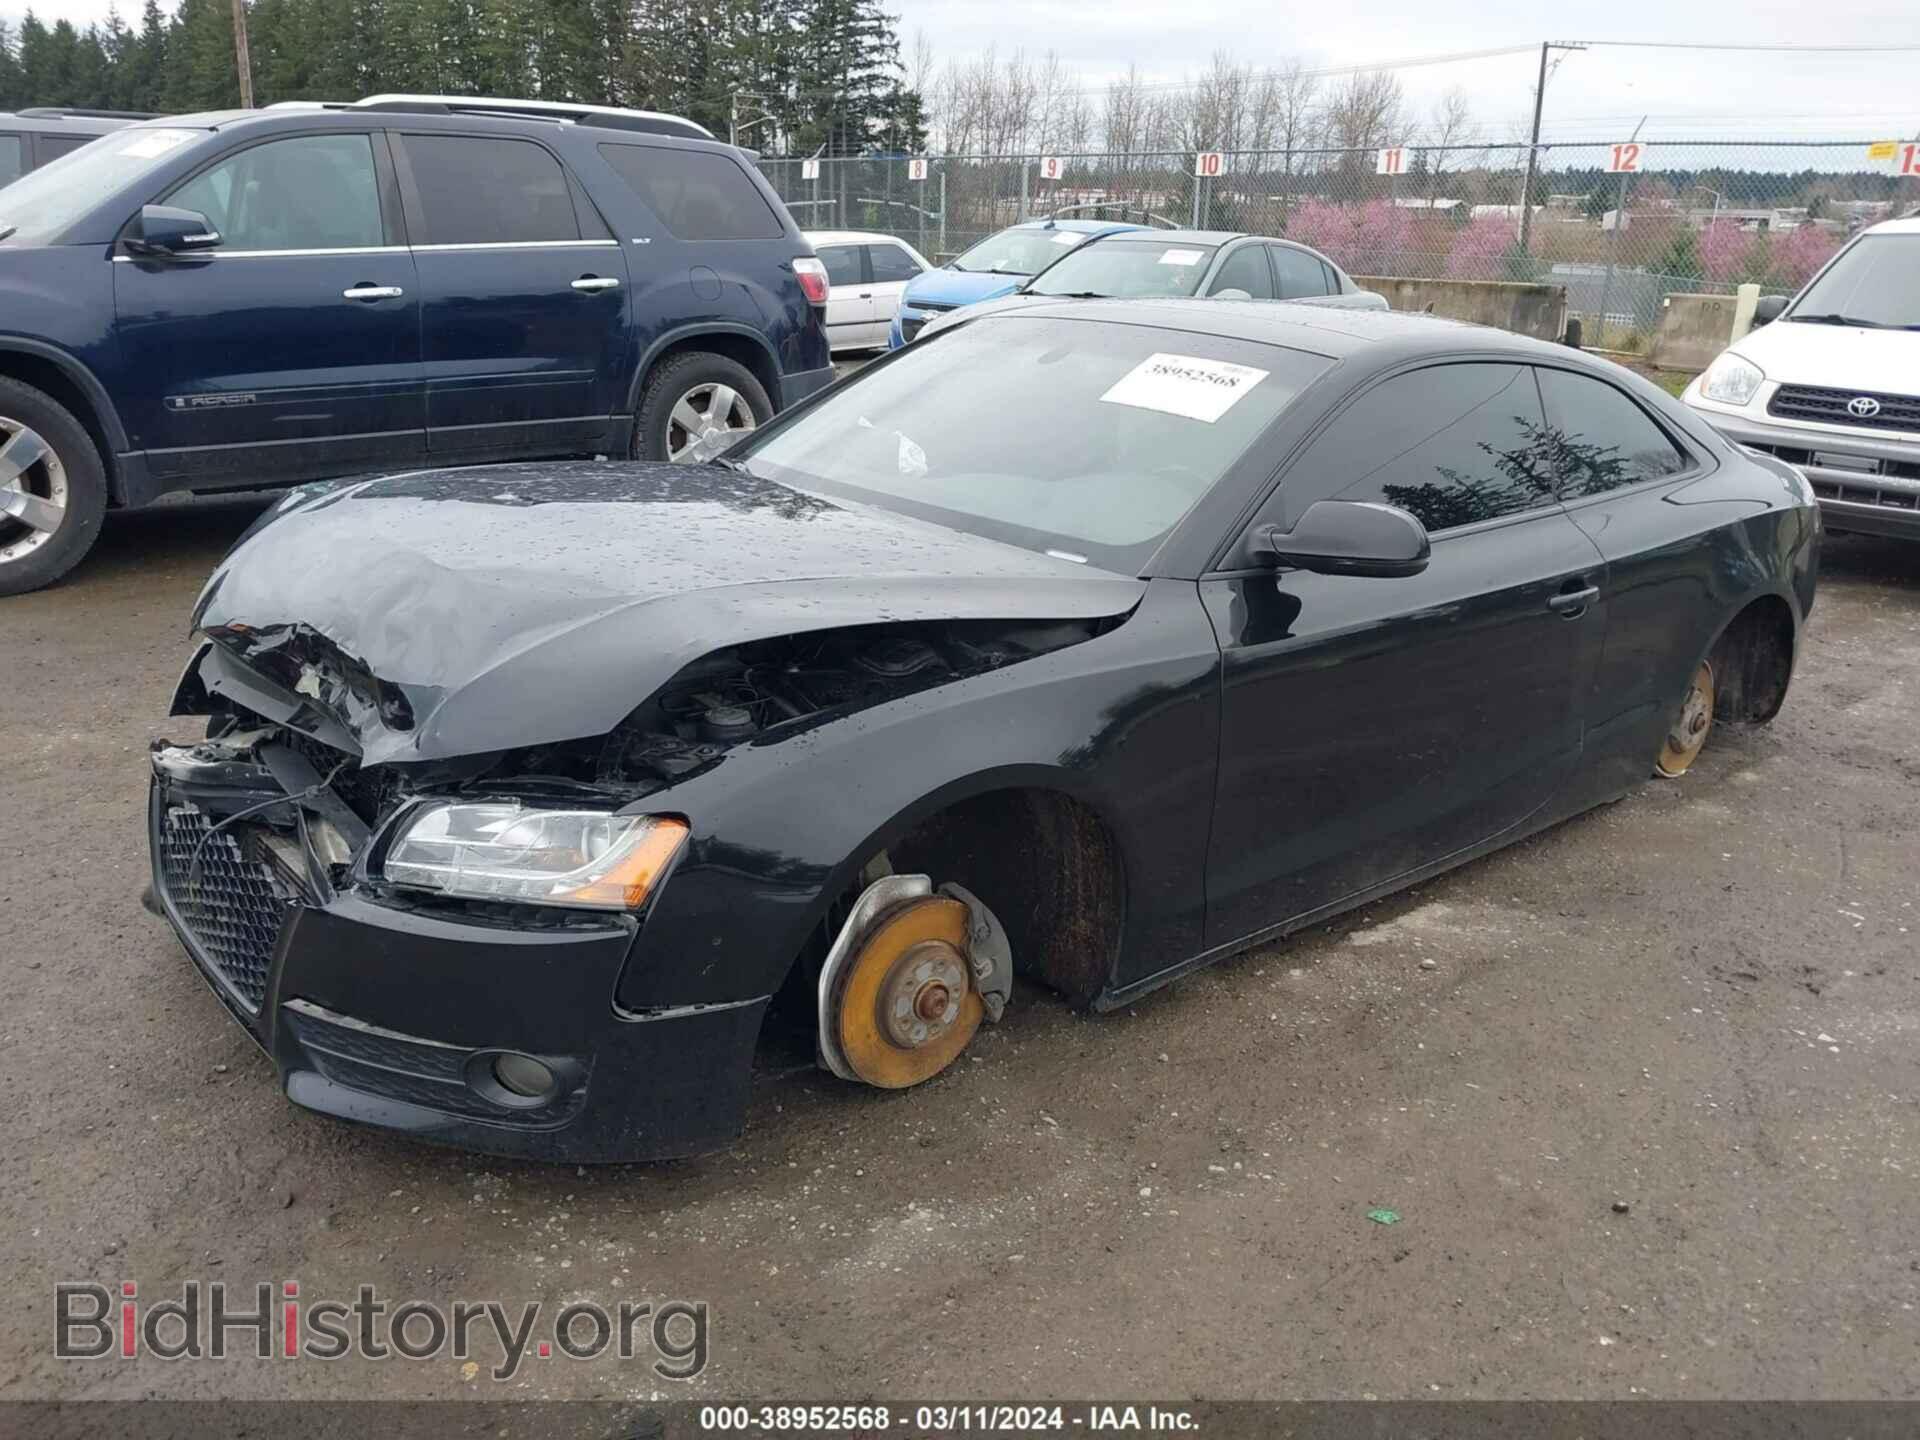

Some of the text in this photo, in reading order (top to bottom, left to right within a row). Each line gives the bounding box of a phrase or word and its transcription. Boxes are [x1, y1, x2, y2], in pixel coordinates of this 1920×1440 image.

[1200, 153, 1219, 175] 10
[1385, 150, 1402, 173] 11
[1611, 143, 1640, 171] 12
[807, 160, 816, 178] 7
[914, 160, 923, 178] 8
[1047, 158, 1057, 178] 9
[1144, 363, 1242, 388] 38952568
[191, 394, 256, 407] ACADIA
